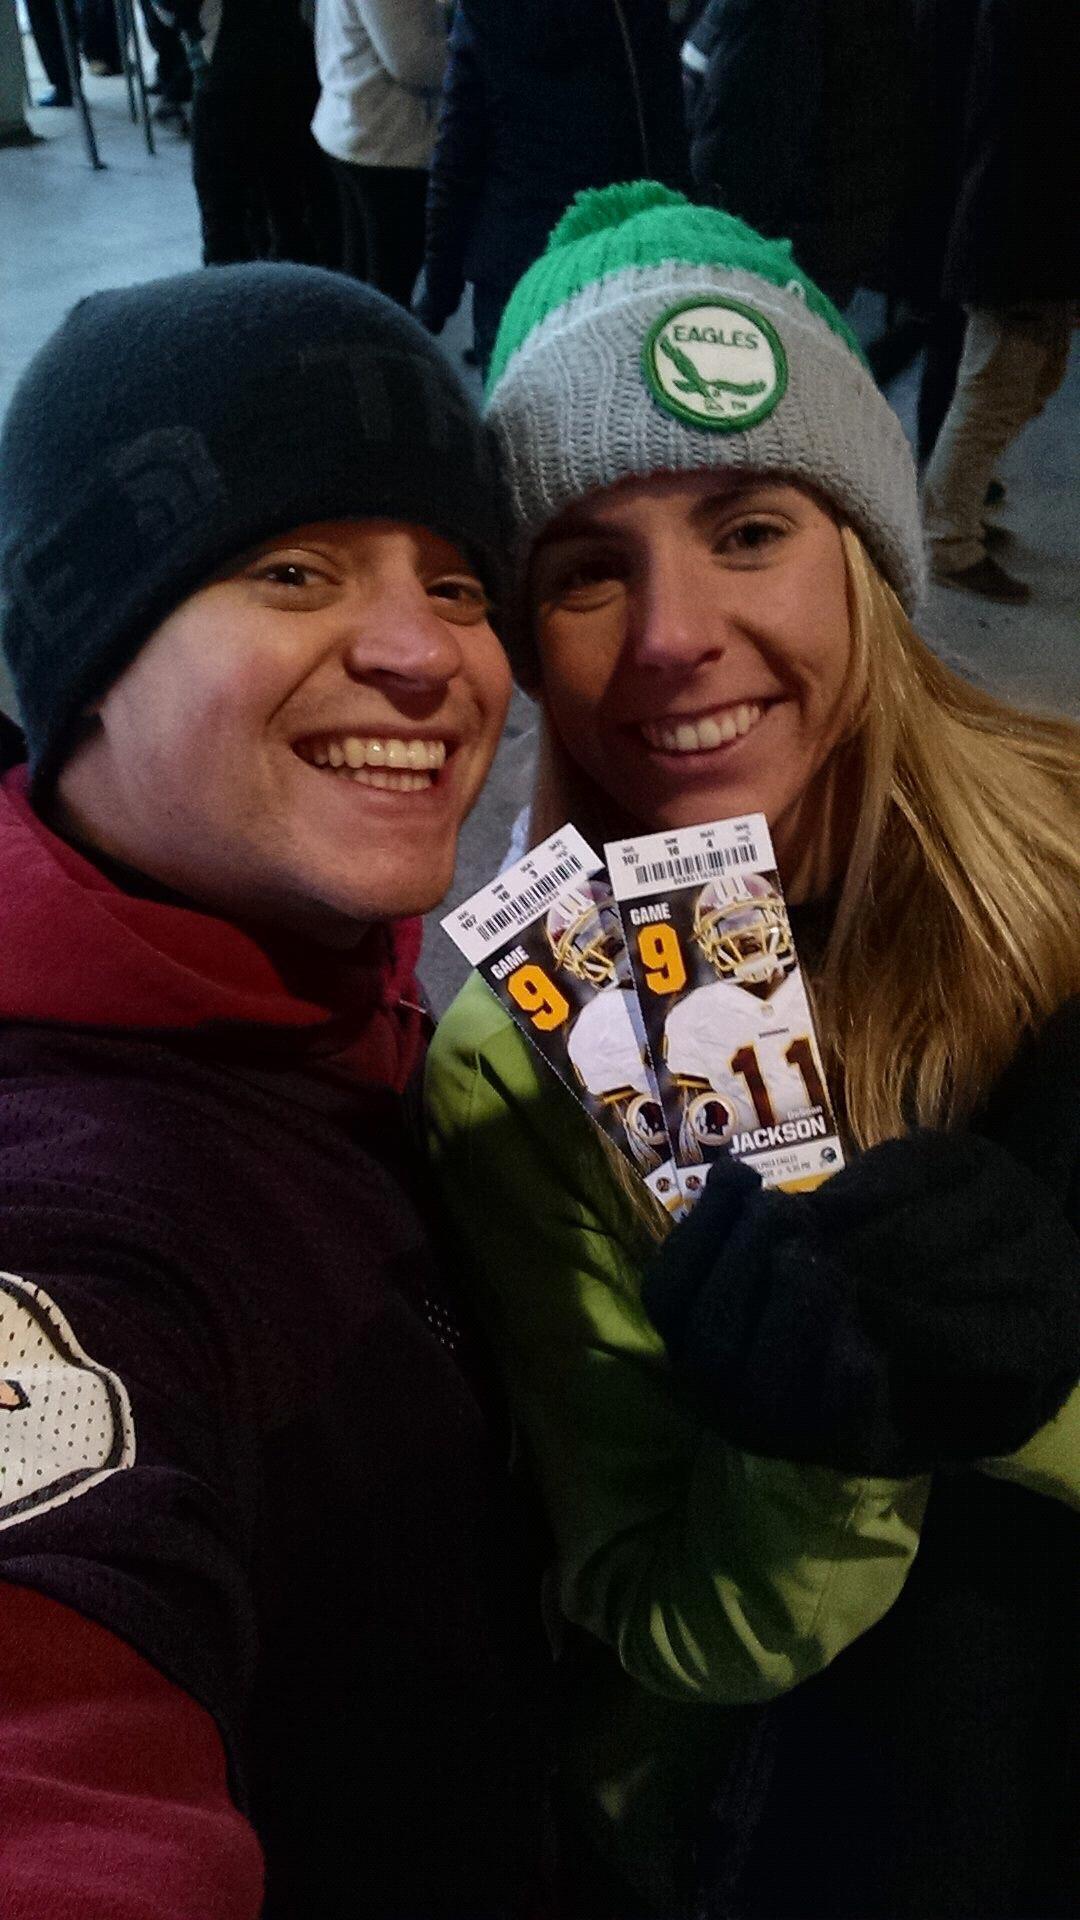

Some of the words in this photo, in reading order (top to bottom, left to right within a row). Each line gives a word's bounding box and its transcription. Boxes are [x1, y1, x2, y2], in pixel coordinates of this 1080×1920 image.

[673, 325, 759, 350] EAGLES
[621, 854, 639, 866] 107
[460, 914, 479, 931] 107
[630, 902, 672, 926] GAME
[490, 945, 530, 980] GAME
[638, 924, 687, 994] 9
[508, 964, 569, 1031] 9
[729, 1038, 823, 1130] 11
[731, 1117, 826, 1153] JACKSON
